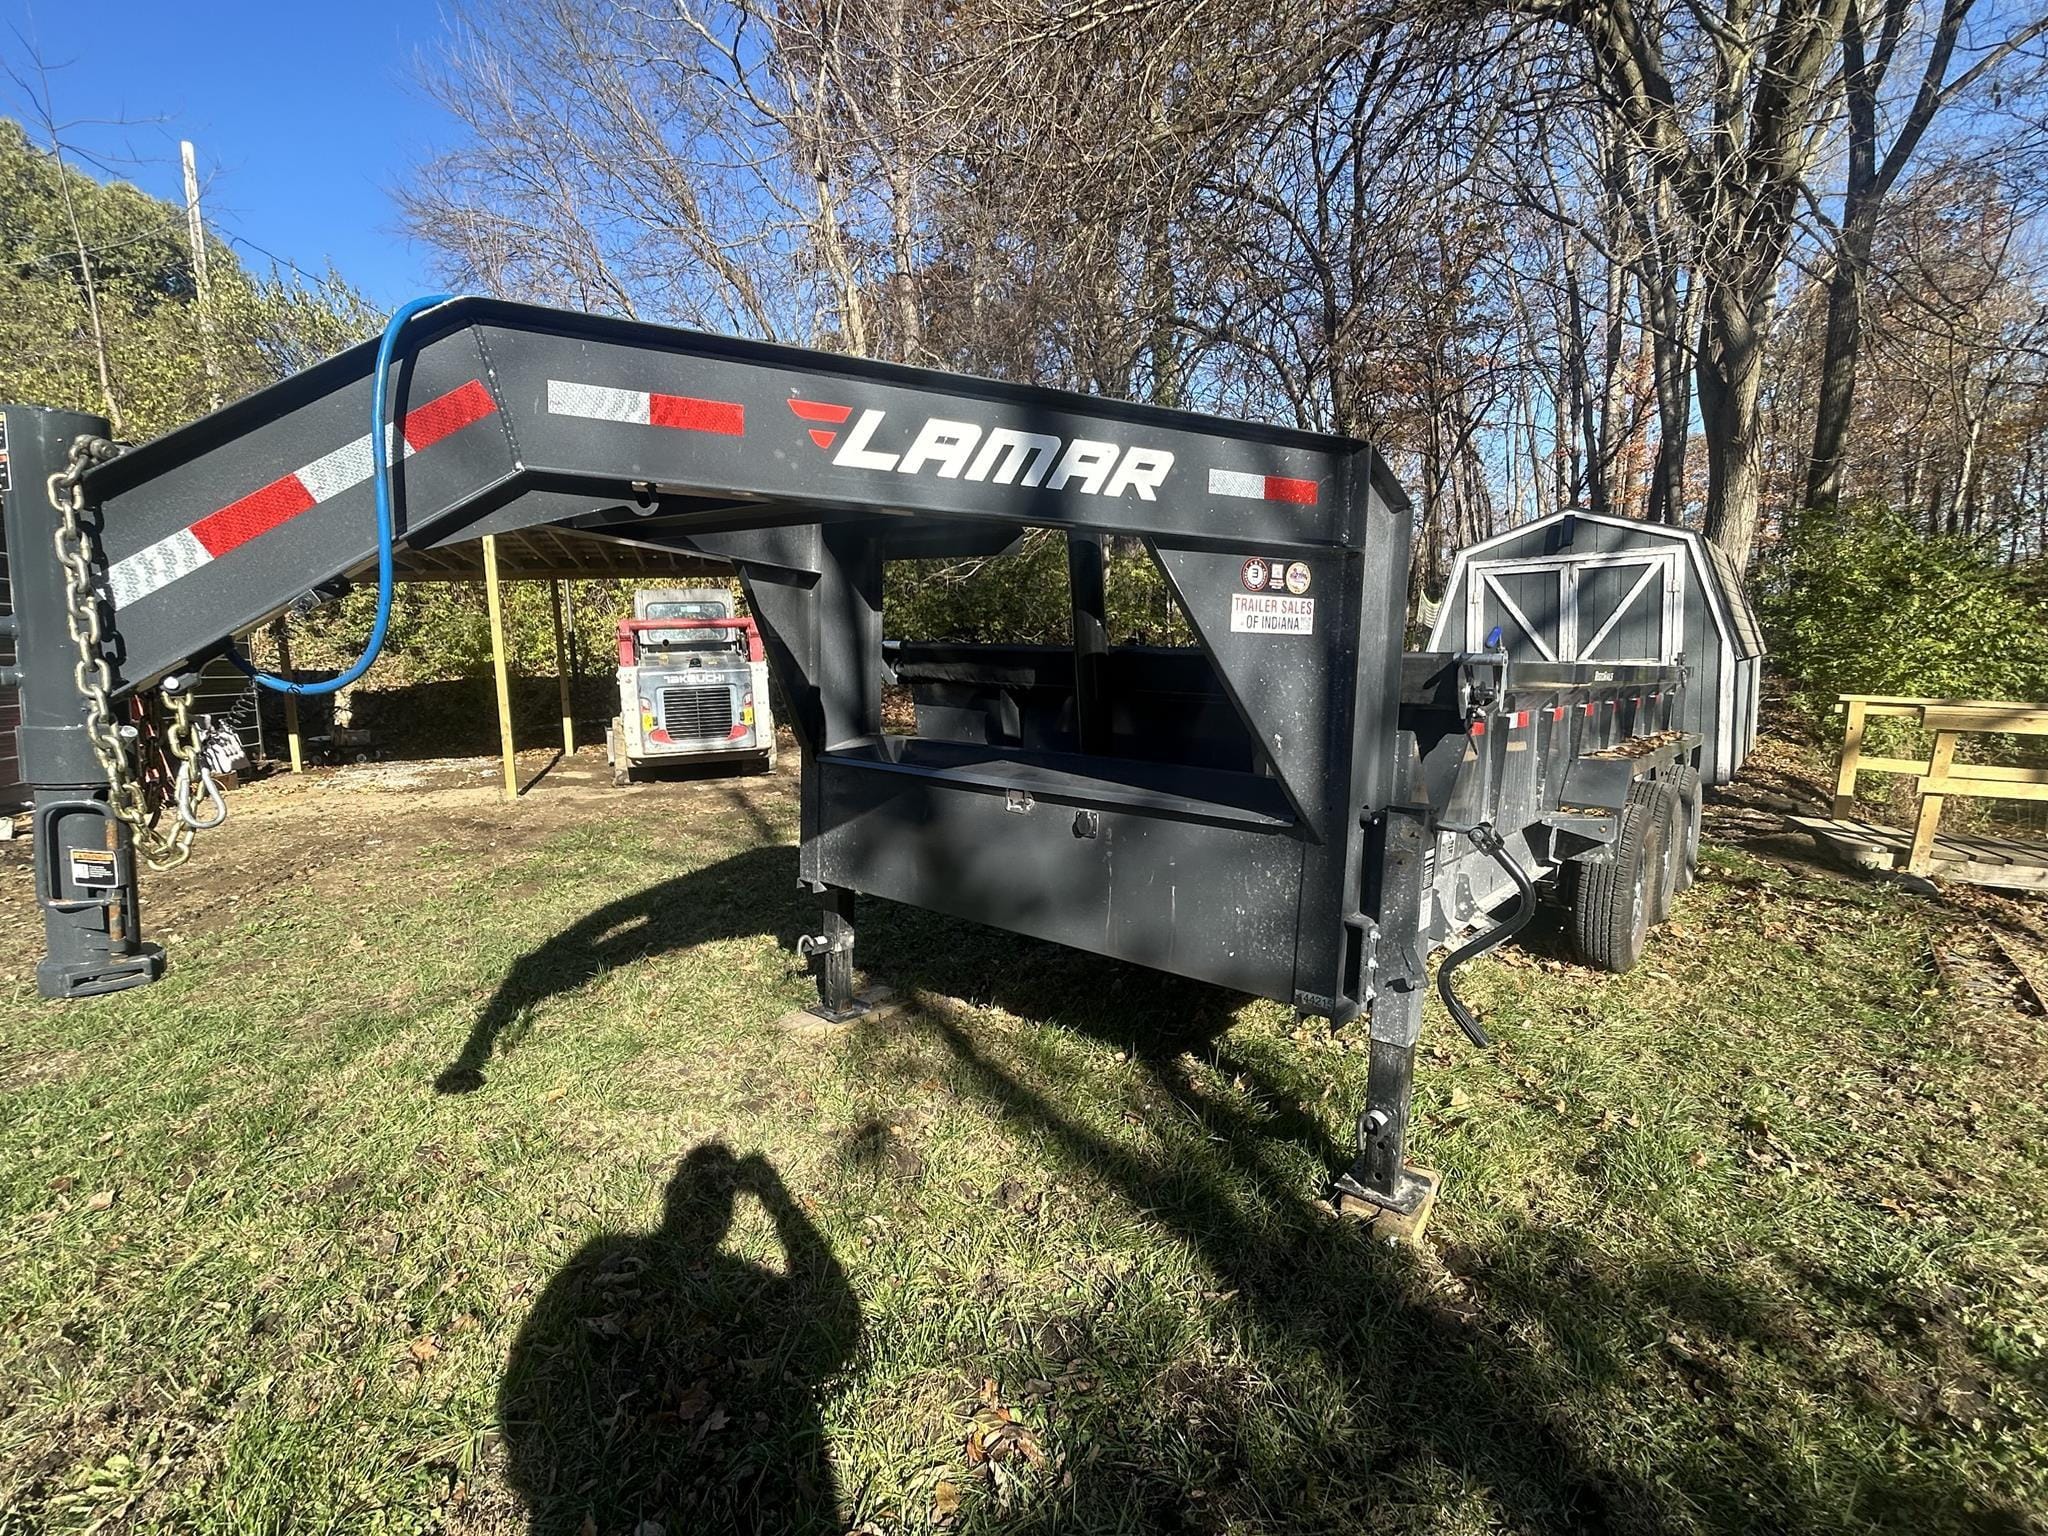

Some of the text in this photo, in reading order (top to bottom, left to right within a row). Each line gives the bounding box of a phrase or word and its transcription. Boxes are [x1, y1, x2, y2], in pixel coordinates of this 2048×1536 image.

[832, 408, 1175, 502] LAMAR
[1235, 597, 1313, 615] TRAILER SALES
[1246, 614, 1300, 631] OF INDIANA
